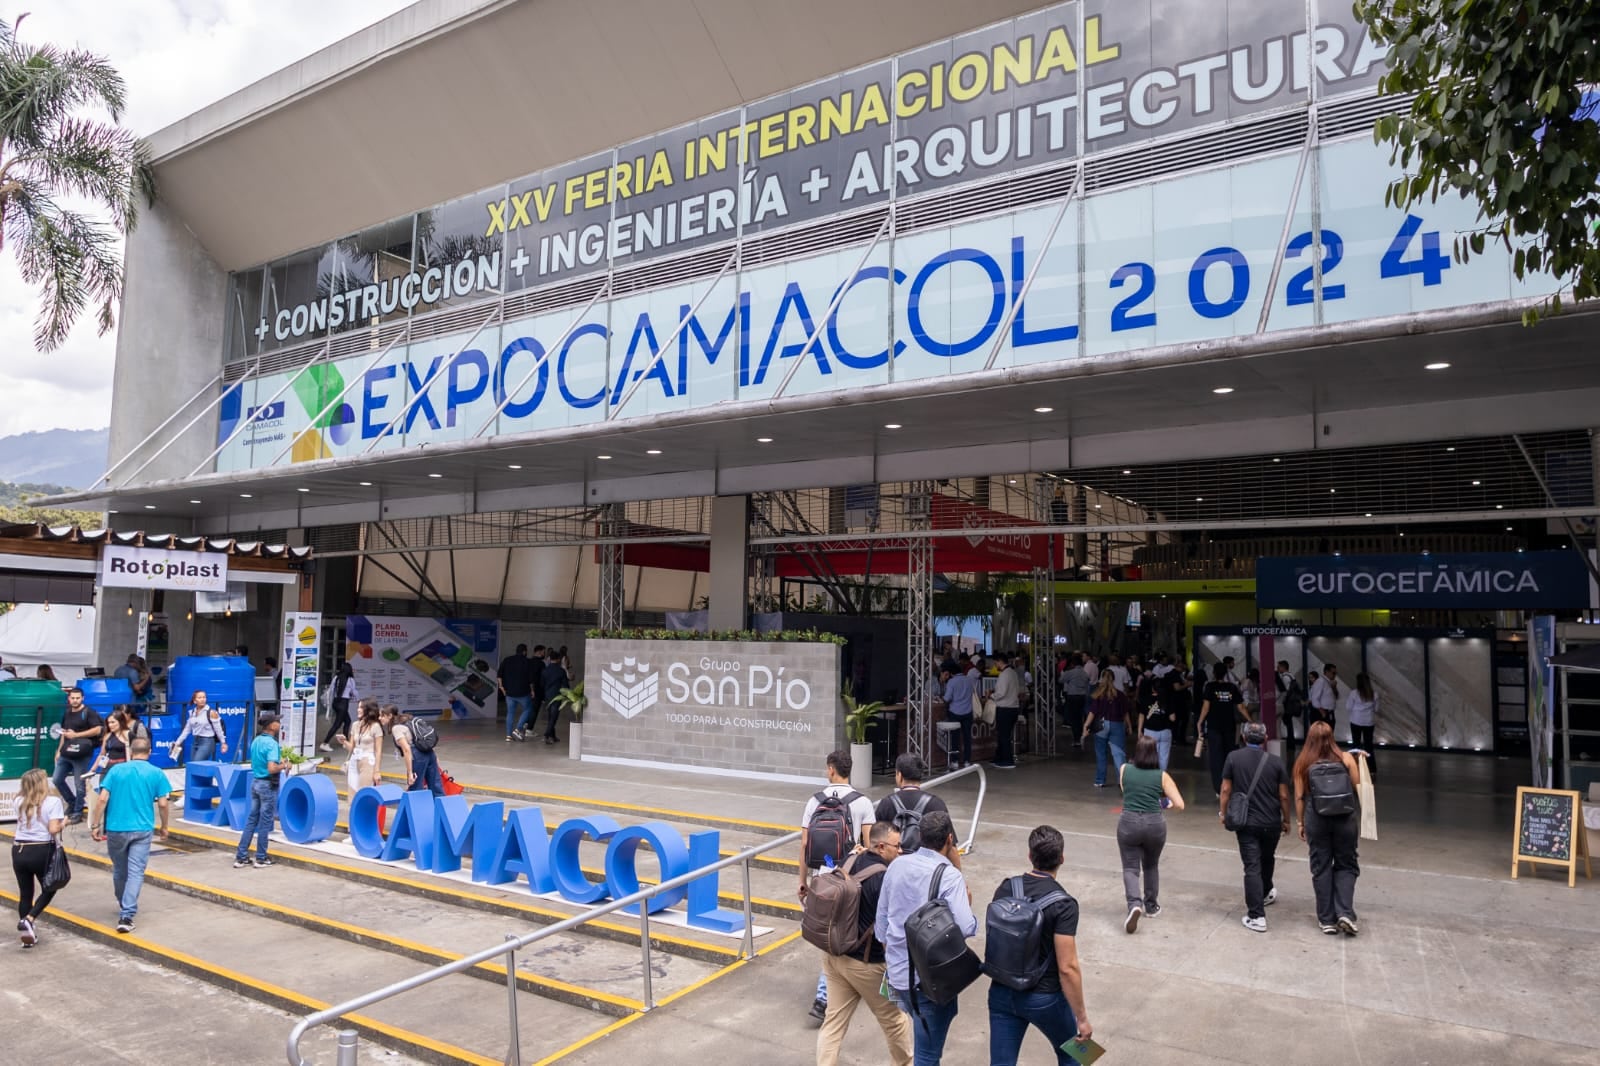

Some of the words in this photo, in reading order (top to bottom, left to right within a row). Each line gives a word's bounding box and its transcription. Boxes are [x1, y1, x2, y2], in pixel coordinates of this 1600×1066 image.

[486, 184, 555, 238] XXV
[564, 150, 673, 216] FERIA
[684, 16, 1120, 180] INTERNACIONAL
[274, 246, 500, 341] CONSTRUCCIÓN
[538, 162, 788, 275] INGENIERÍA
[842, 24, 1390, 202] ARQUITECTURA
[361, 236, 1079, 441] EXPOCAMACOL
[246, 420, 284, 431] CAMACOL
[111, 558, 219, 579] Rotoplast
[700, 657, 741, 673] Grupo
[666, 662, 740, 706] San
[748, 665, 811, 710] Pío
[665, 713, 691, 724] TODO
[692, 714, 718, 726] PARA
[719, 717, 731, 726] LA
[733, 717, 811, 733] CONSTRUCCIÓN
